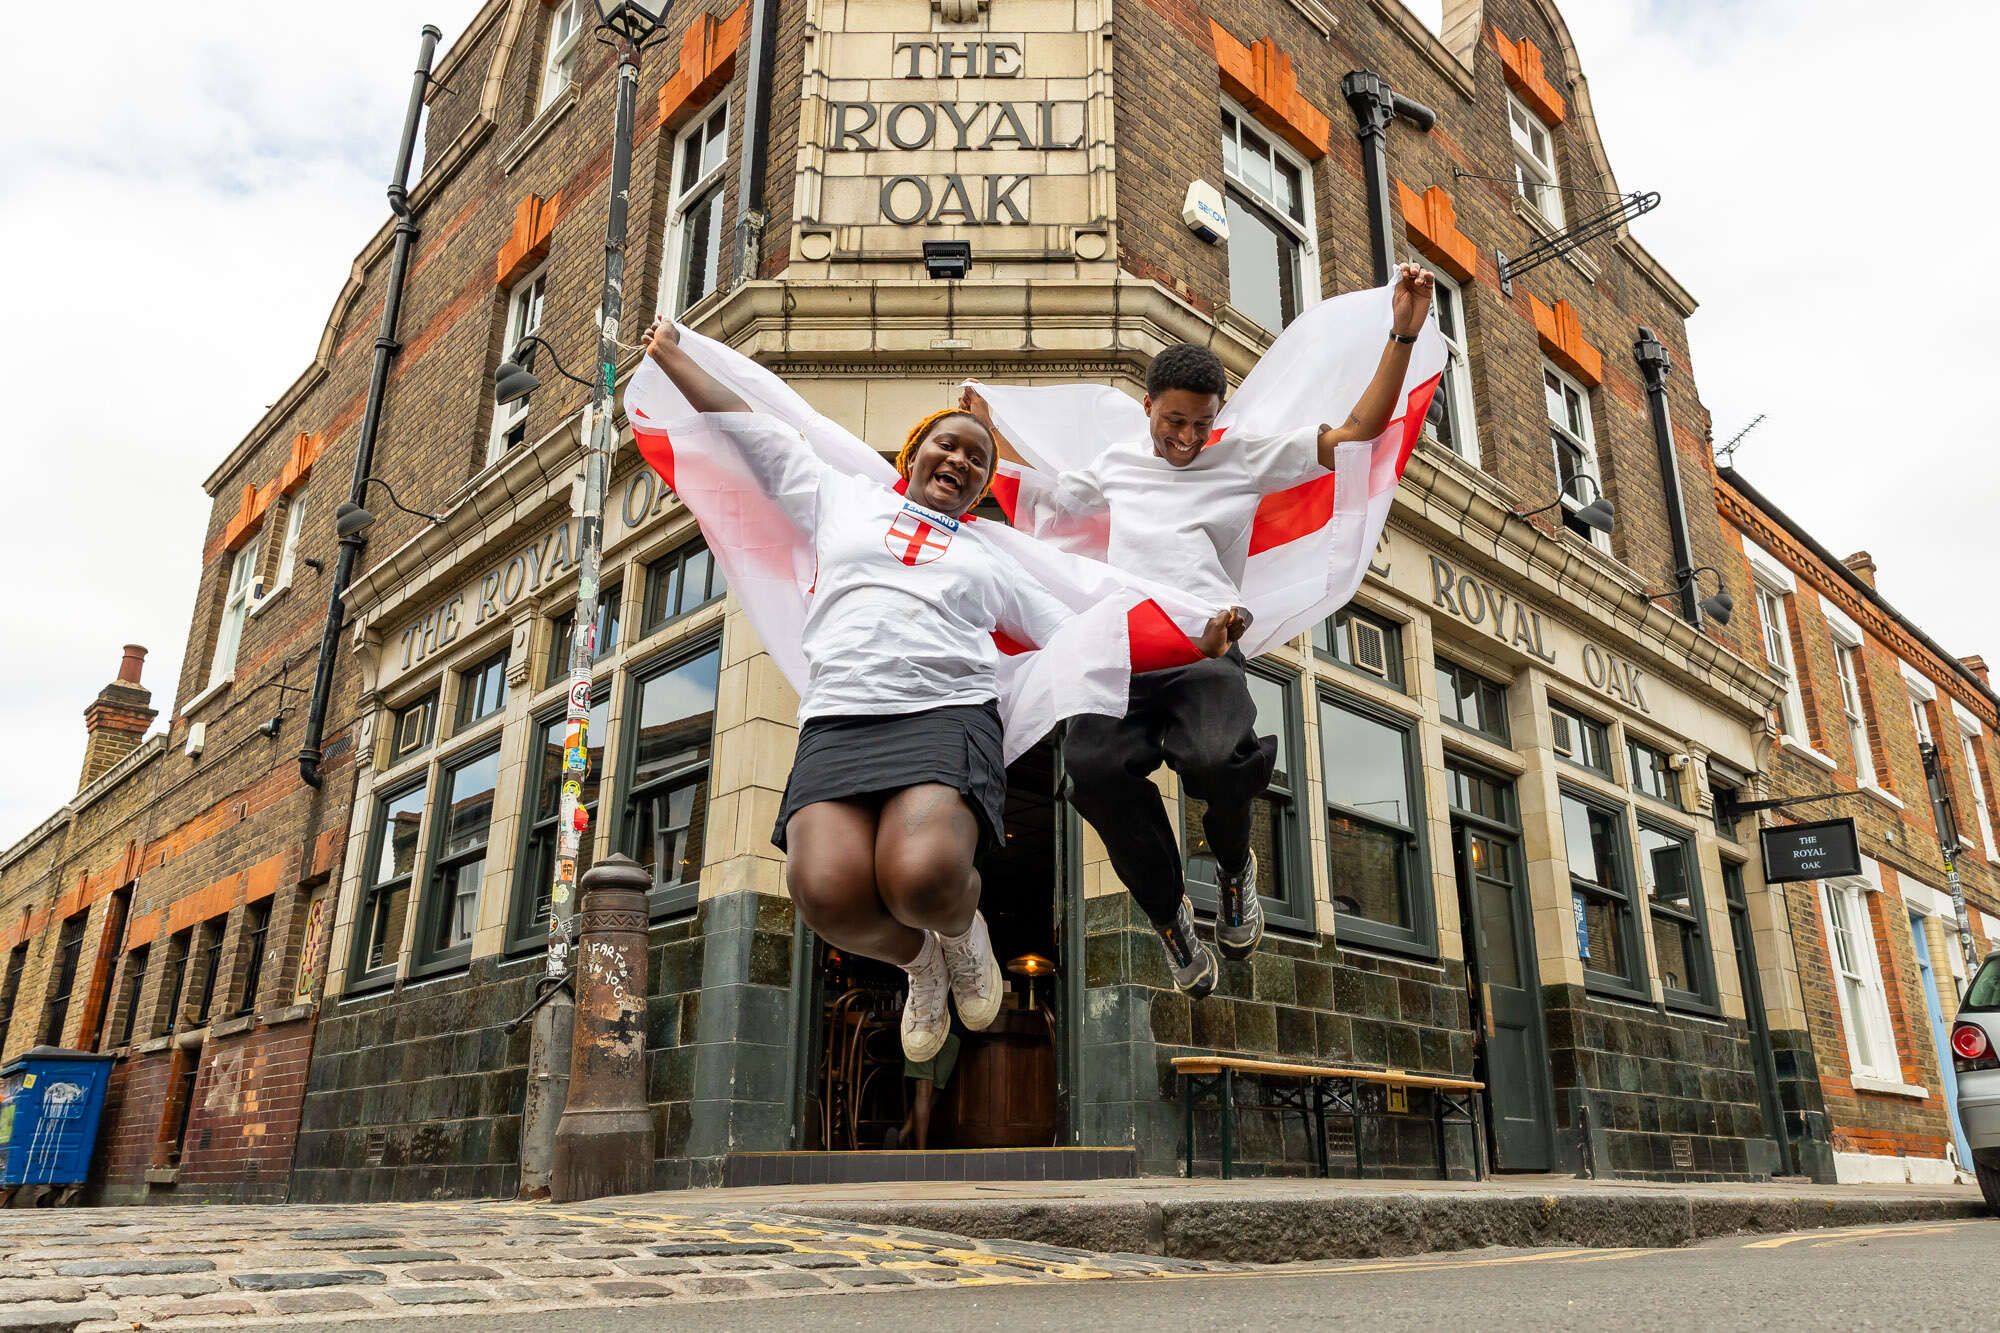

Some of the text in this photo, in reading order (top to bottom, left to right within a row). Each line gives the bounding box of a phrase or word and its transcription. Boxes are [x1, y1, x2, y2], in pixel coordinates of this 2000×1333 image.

[895, 42, 1022, 79] THE
[831, 101, 1083, 151] ROYAL
[880, 174, 1030, 225] OAK
[401, 592, 464, 671] THE
[1430, 555, 1651, 714] ROYAL OAK
[1792, 848, 1827, 858] ROYAL
[1799, 836, 1817, 845] THE
[1801, 861, 1821, 870] OAK
